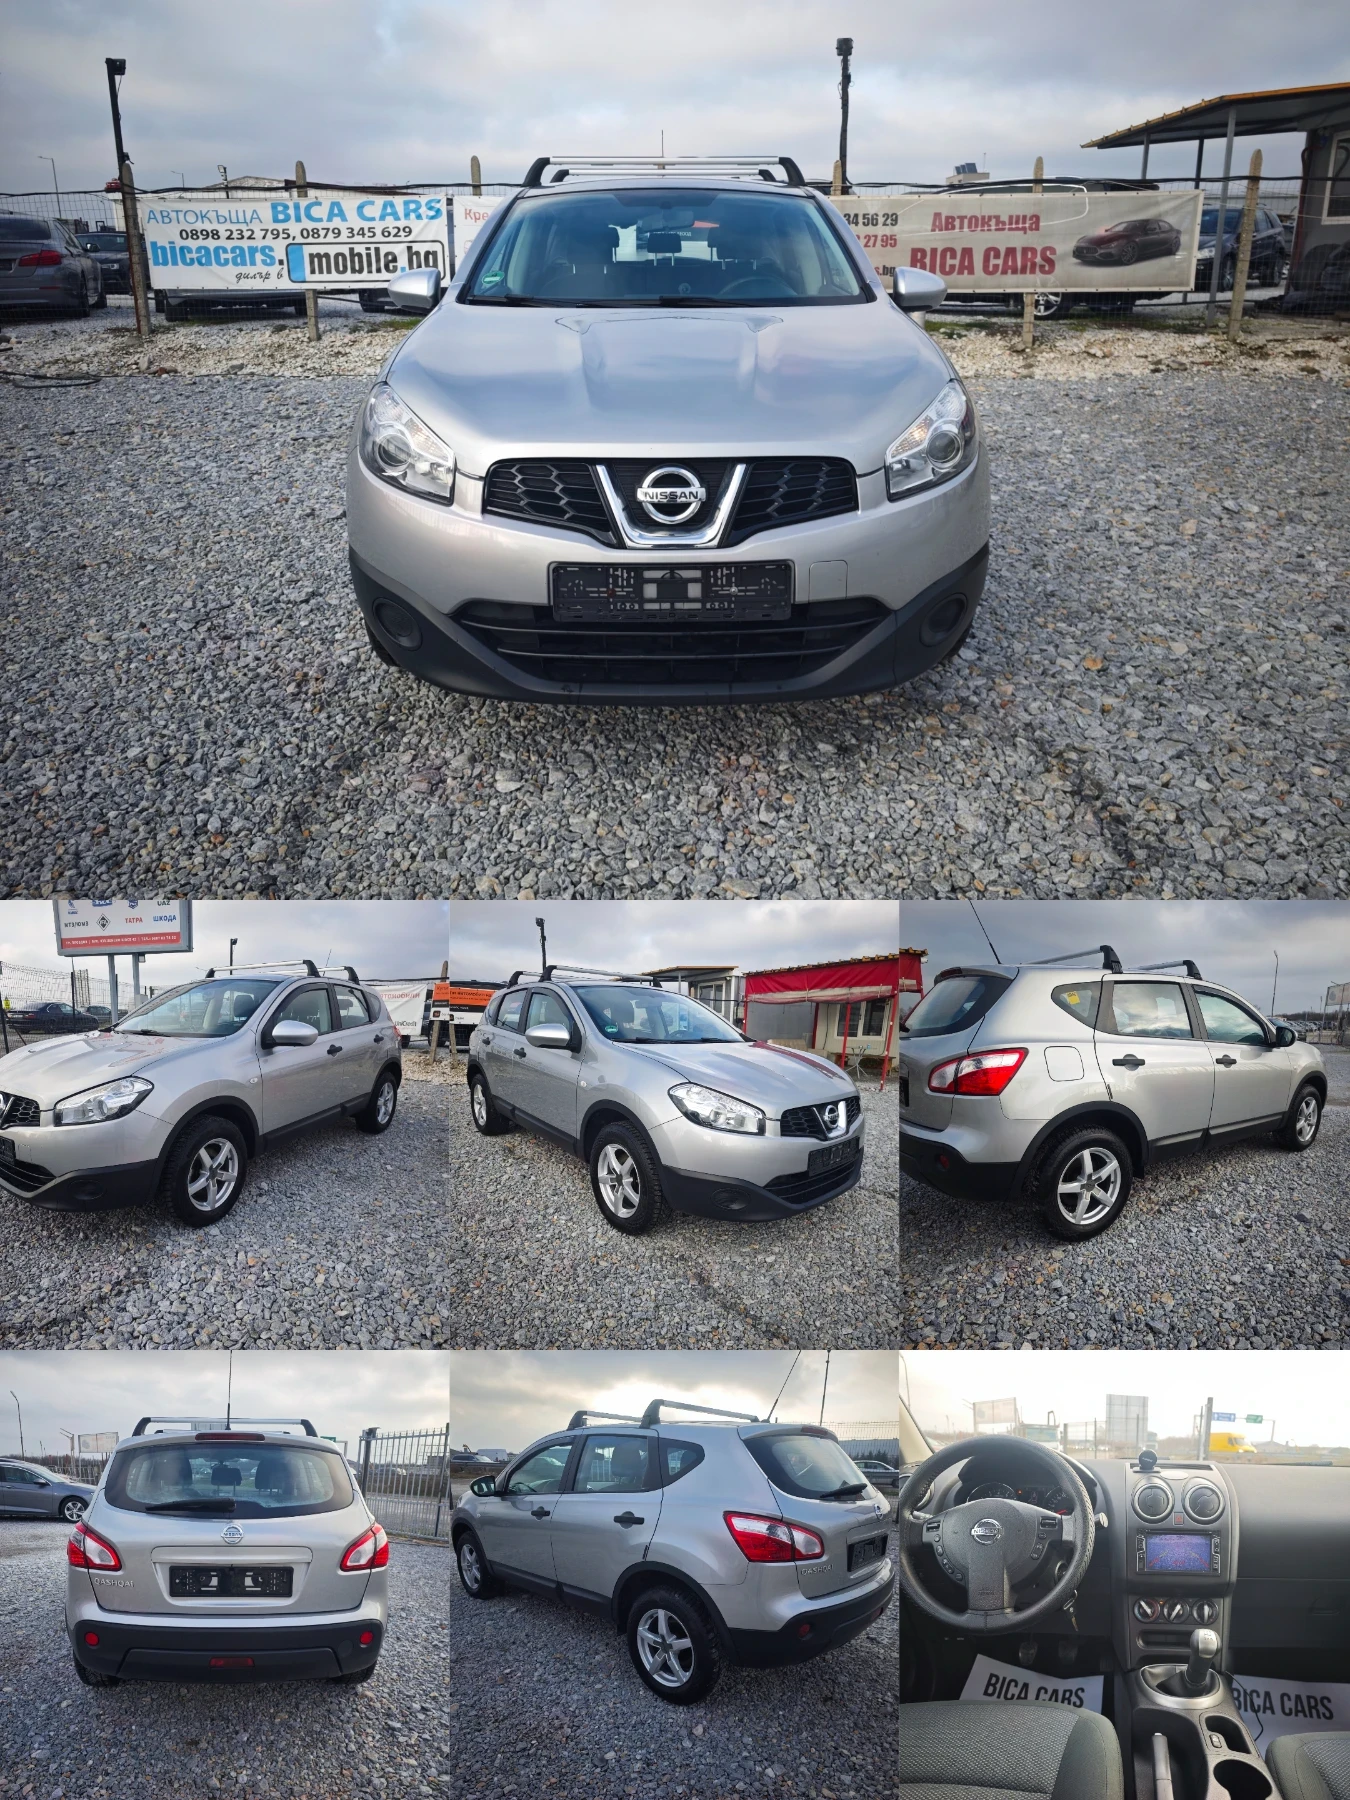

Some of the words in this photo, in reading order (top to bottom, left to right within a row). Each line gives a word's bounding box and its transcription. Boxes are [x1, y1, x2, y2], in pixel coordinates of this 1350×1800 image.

[147, 209, 263, 227] АВТОКЪЩА
[270, 201, 348, 224] BICA
[356, 198, 444, 222] CARS
[464, 208, 490, 223] Кре
[862, 213, 879, 227] 56
[882, 212, 899, 227] 29
[931, 212, 1041, 234] Автокъща
[179, 228, 221, 241] 0898
[225, 228, 256, 240] 232
[260, 228, 296, 241] 795,
[300, 227, 341, 240] 0879
[346, 226, 377, 239] 345
[381, 225, 413, 238] 629
[863, 234, 878, 248] 27
[881, 234, 898, 248] 95
[910, 247, 975, 276] BICA
[982, 246, 1057, 276] CARS
[235, 270, 272, 284] дилър
[276, 267, 285, 280] в
[643, 490, 699, 500] NISSAN
[983, 1673, 1030, 1701] BICA
[1034, 1686, 1085, 1708] CARS
[1232, 1687, 1276, 1715] BICA
[1280, 1692, 1334, 1721] CARS
